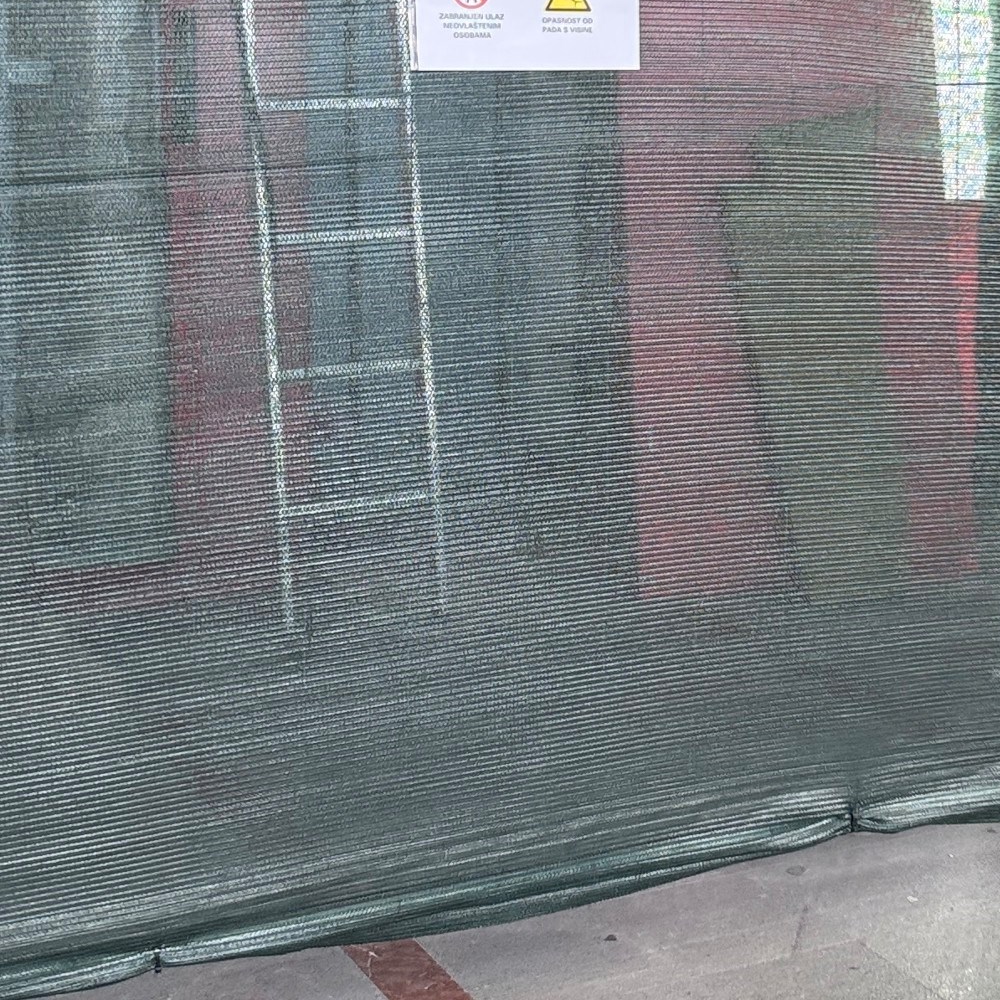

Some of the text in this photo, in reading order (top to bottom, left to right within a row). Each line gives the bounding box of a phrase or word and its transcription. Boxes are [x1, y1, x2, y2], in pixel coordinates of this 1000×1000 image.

[439, 12, 505, 21] ZABRANJEN ULAZ
[542, 16, 594, 25] OPASNOST OD
[443, 21, 502, 29] NEOVLAŠTENIM
[570, 26, 593, 34] VISINE
[453, 31, 492, 39] OSOBAMA
